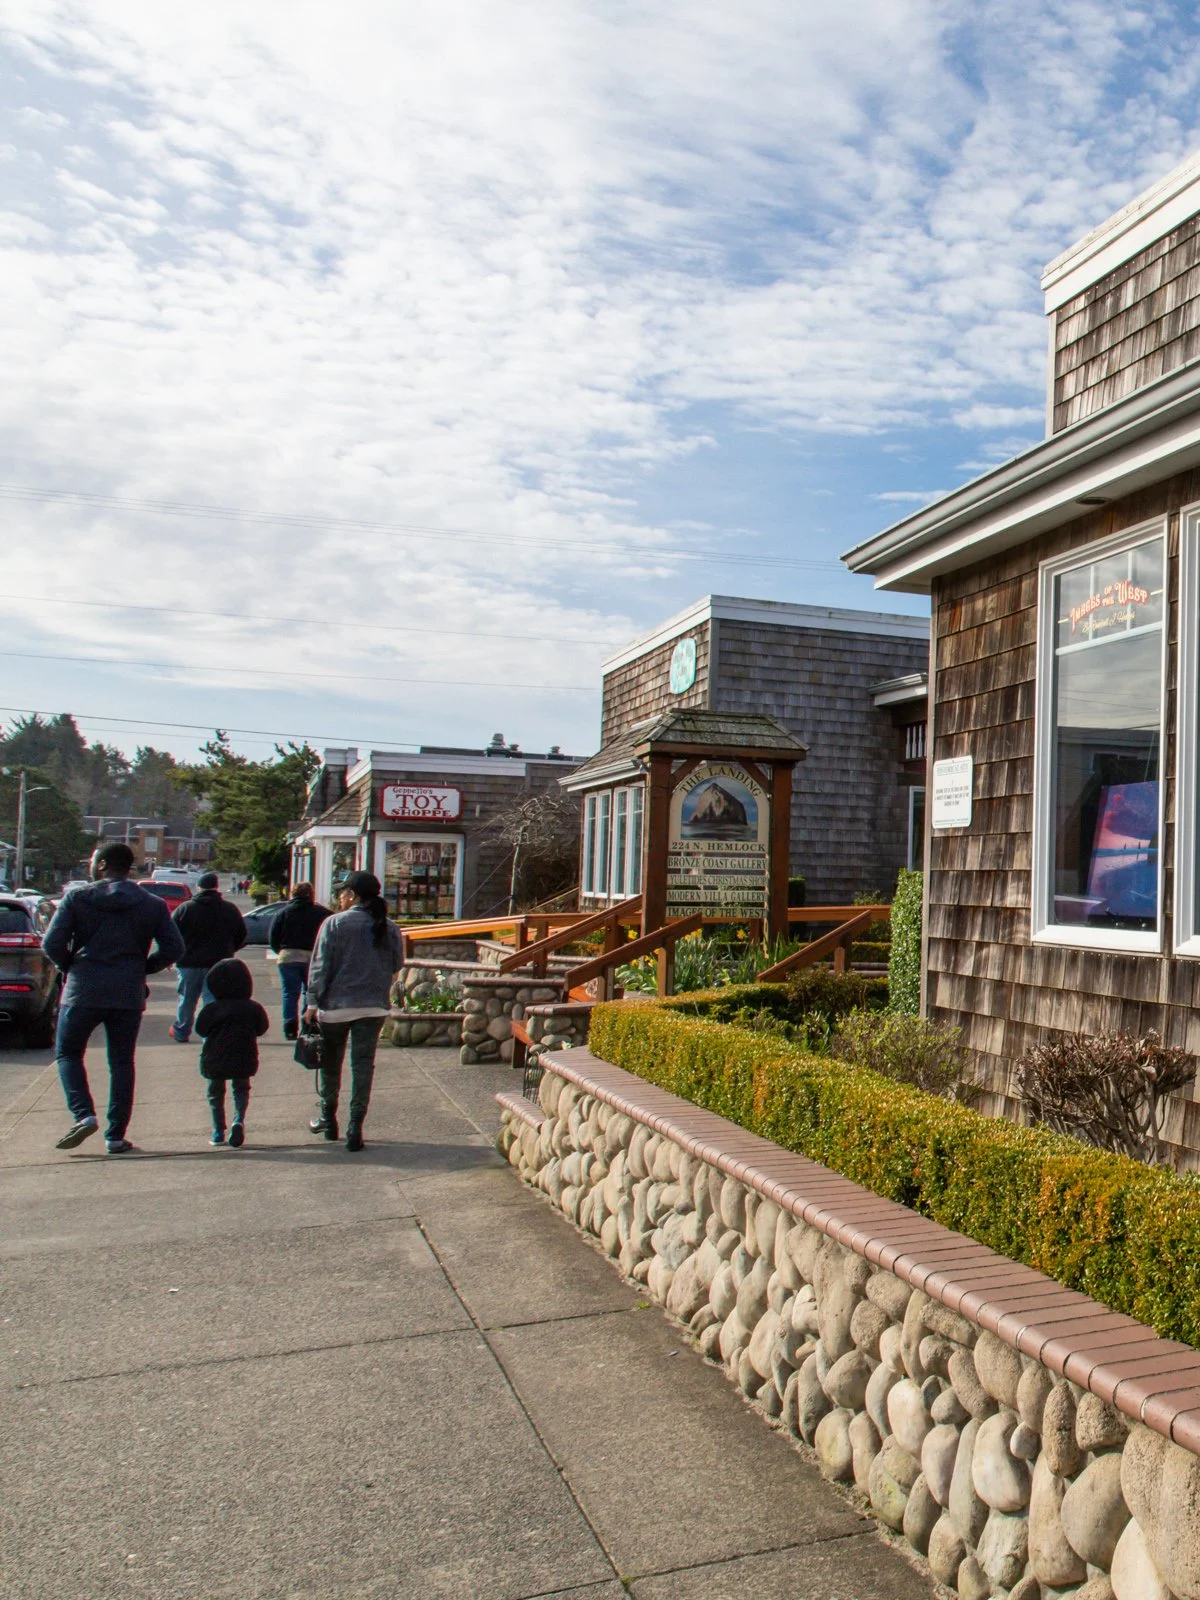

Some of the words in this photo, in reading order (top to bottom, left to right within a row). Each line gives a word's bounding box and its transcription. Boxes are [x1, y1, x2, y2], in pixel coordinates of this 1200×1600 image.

[680, 774, 704, 793] THE
[708, 767, 762, 797] LANDING
[395, 795, 448, 810] TOY
[391, 809, 451, 817] SHOPPE
[672, 841, 690, 850] 224
[693, 842, 703, 850] N.
[707, 842, 766, 852] HEMLOCK
[405, 848, 433, 862] OPEN
[668, 857, 701, 868] BRONZE
[702, 859, 728, 869] COAST
[730, 859, 766, 870] GALLERY
[668, 892, 701, 901] MODERN
[704, 892, 728, 902] VILLA
[731, 892, 765, 902] GALLERY
[705, 908, 718, 918] OF
[720, 908, 738, 918] THE
[740, 909, 765, 919] WEST
